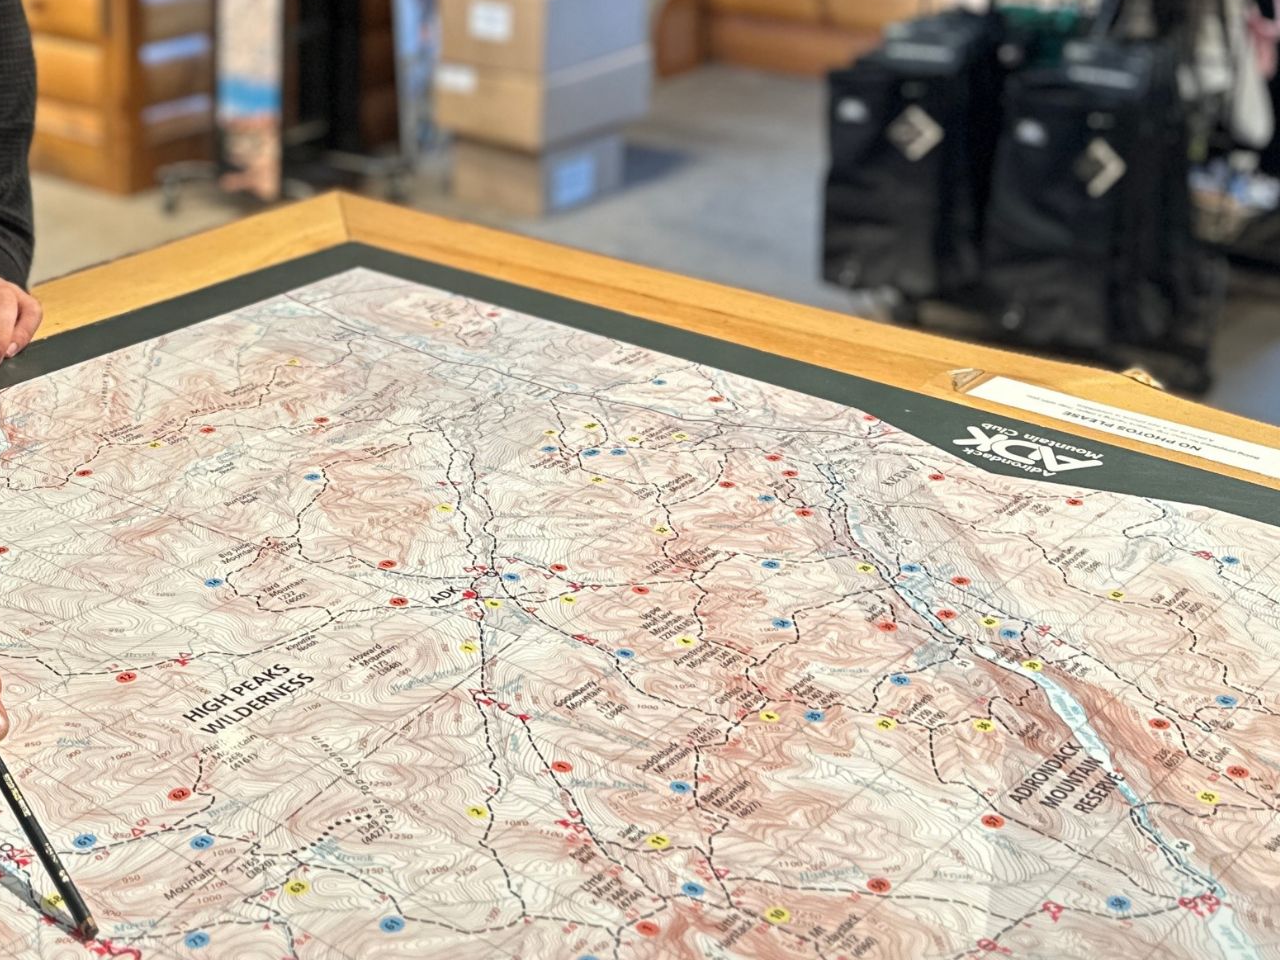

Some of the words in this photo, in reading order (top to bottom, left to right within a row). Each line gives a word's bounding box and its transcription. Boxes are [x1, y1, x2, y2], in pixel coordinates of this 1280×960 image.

[981, 422, 1021, 437] Club
[1062, 409, 1114, 428] PLEASE
[1117, 424, 1176, 444] PHOTOS
[953, 425, 1103, 472] ADK
[1023, 433, 1104, 460] Mountain
[1178, 441, 1201, 451] NO
[962, 447, 1056, 477] Adirondack
[431, 586, 462, 605] ADK
[350, 644, 382, 663] Howard
[359, 644, 400, 669] Mountain
[182, 695, 236, 724] HIGH
[236, 663, 291, 698] PEAKS
[200, 672, 316, 736] WILDERNESS
[554, 681, 597, 707] Gooseberry
[566, 687, 603, 711] Mountain
[311, 735, 356, 776] Mountain
[653, 747, 693, 774] Mountain
[1009, 741, 1083, 806] ADIRONDACK
[1039, 756, 1103, 810] MOUNTAIN
[172, 789, 188, 800] 62
[355, 779, 370, 797] Top
[712, 779, 752, 807] Mountain
[1073, 772, 1126, 814] RESERVE
[76, 836, 94, 847] 61
[193, 837, 212, 848] 61
[212, 847, 237, 857] 1050
[425, 866, 449, 875] 1200
[164, 866, 216, 901] Mountain
[290, 882, 306, 893] 63
[196, 895, 223, 905] 1000
[385, 919, 402, 930] 61
